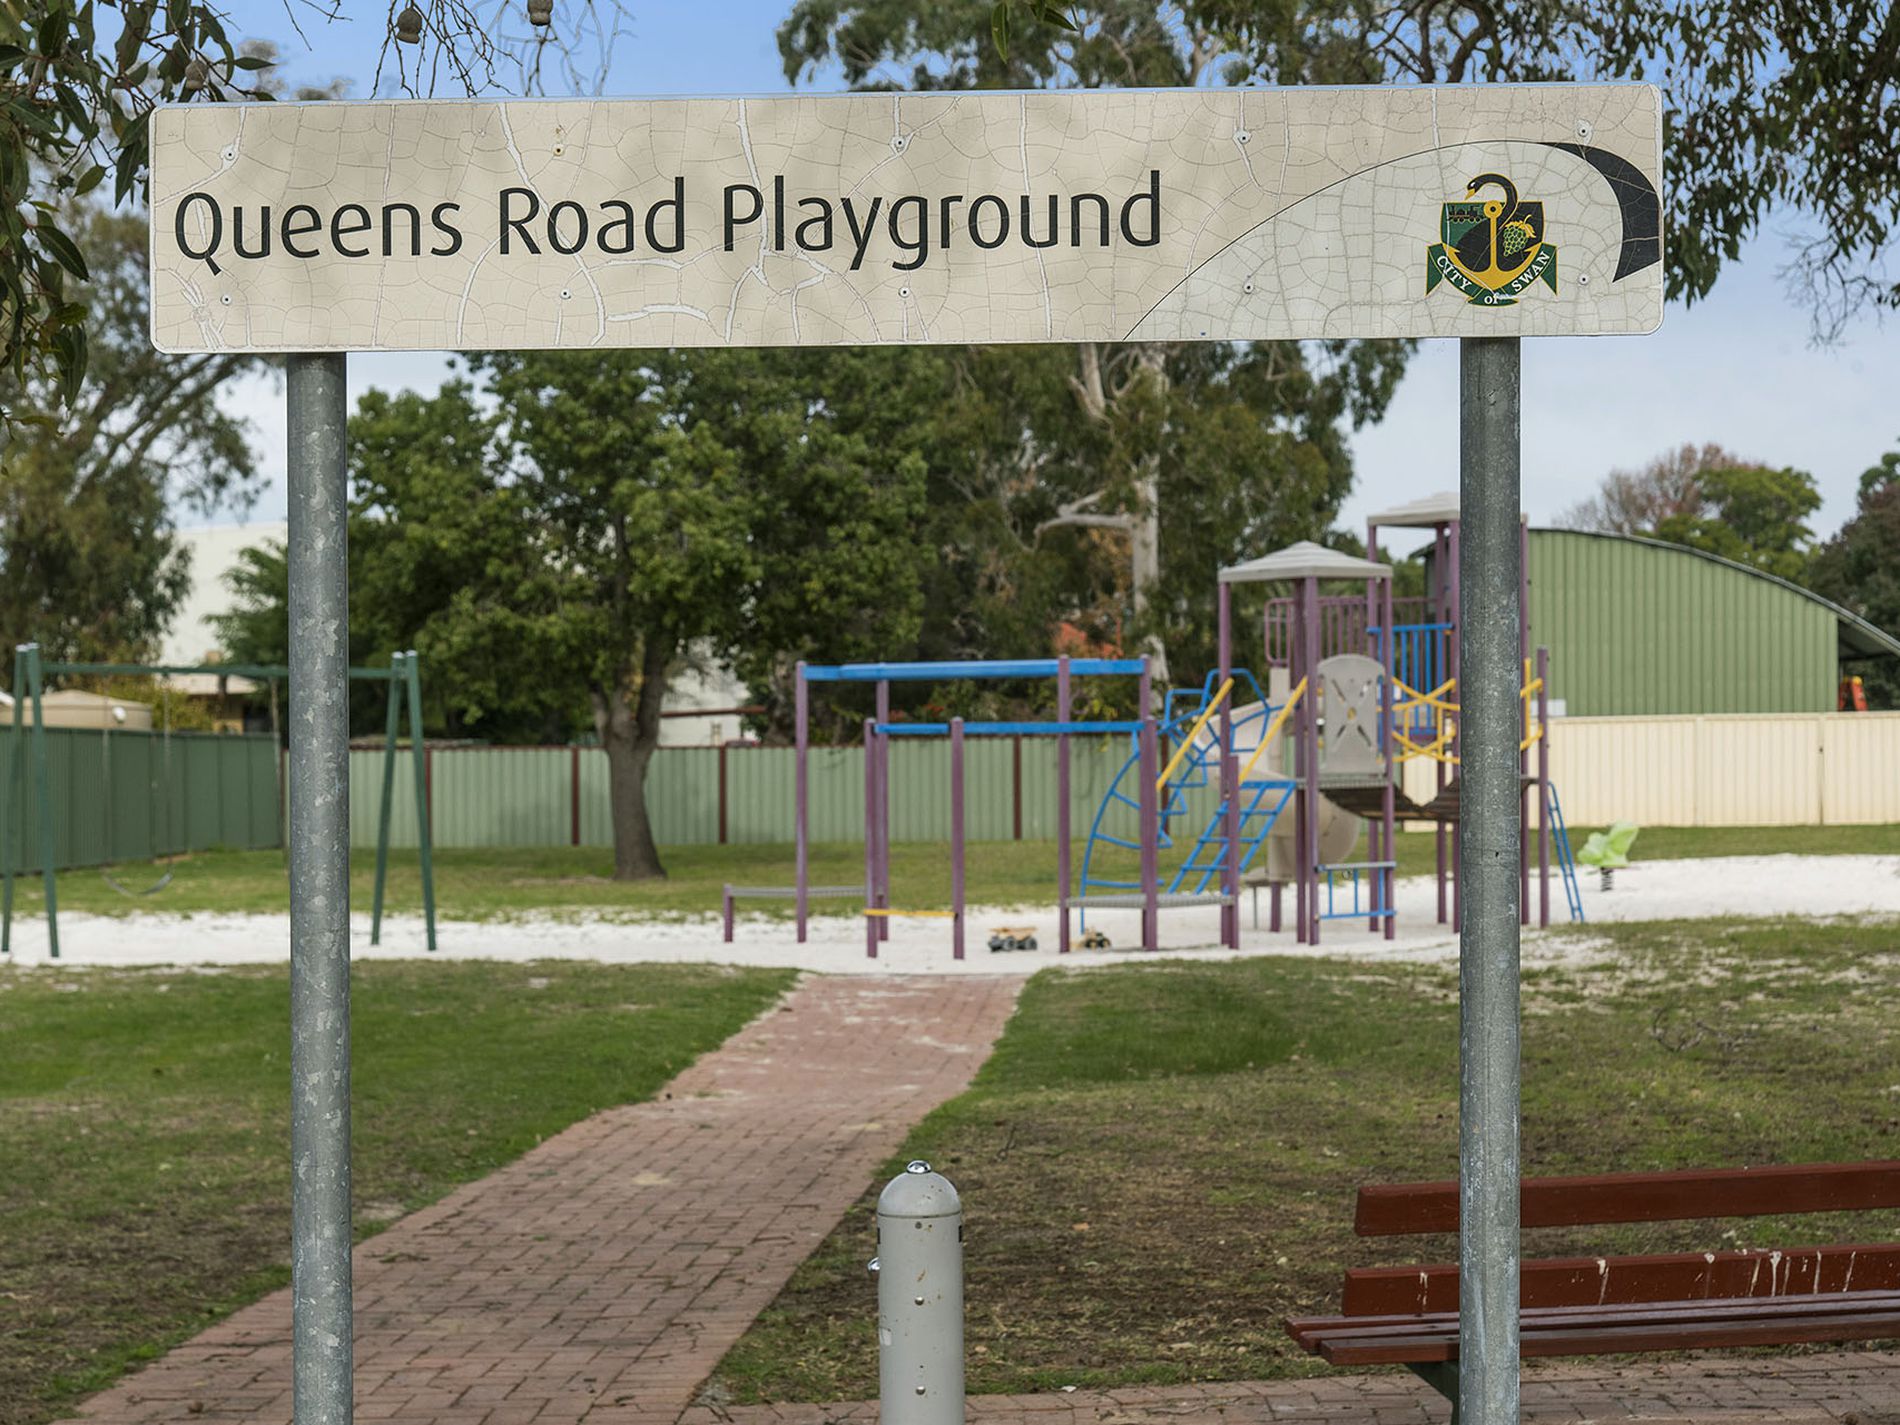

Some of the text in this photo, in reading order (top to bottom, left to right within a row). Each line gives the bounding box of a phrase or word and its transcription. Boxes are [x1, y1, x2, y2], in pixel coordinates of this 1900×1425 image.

[175, 169, 1161, 276] Queens Road Playground
[1436, 255, 1473, 291] CITY
[1511, 251, 1551, 292] SWAN
